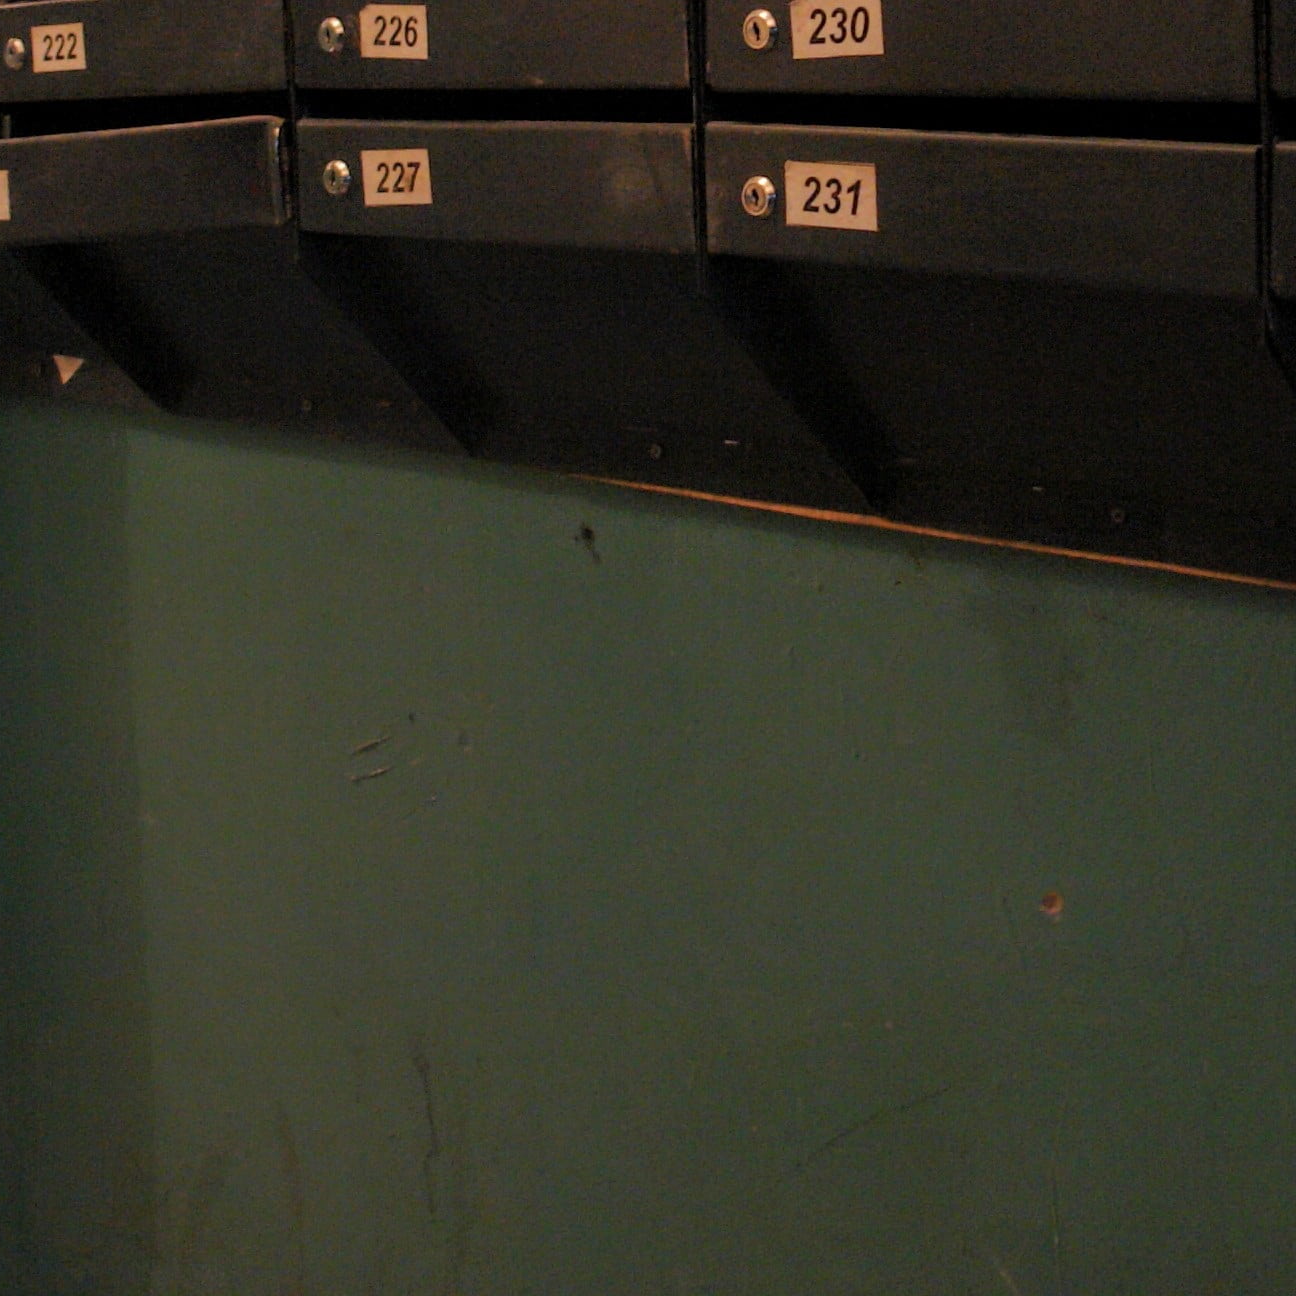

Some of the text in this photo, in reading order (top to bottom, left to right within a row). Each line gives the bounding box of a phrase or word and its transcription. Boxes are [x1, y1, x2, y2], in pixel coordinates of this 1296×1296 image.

[373, 15, 418, 47] 226
[809, 7, 870, 44] 230
[42, 33, 78, 62] 222
[376, 162, 421, 193] 227
[803, 177, 862, 216] 231
